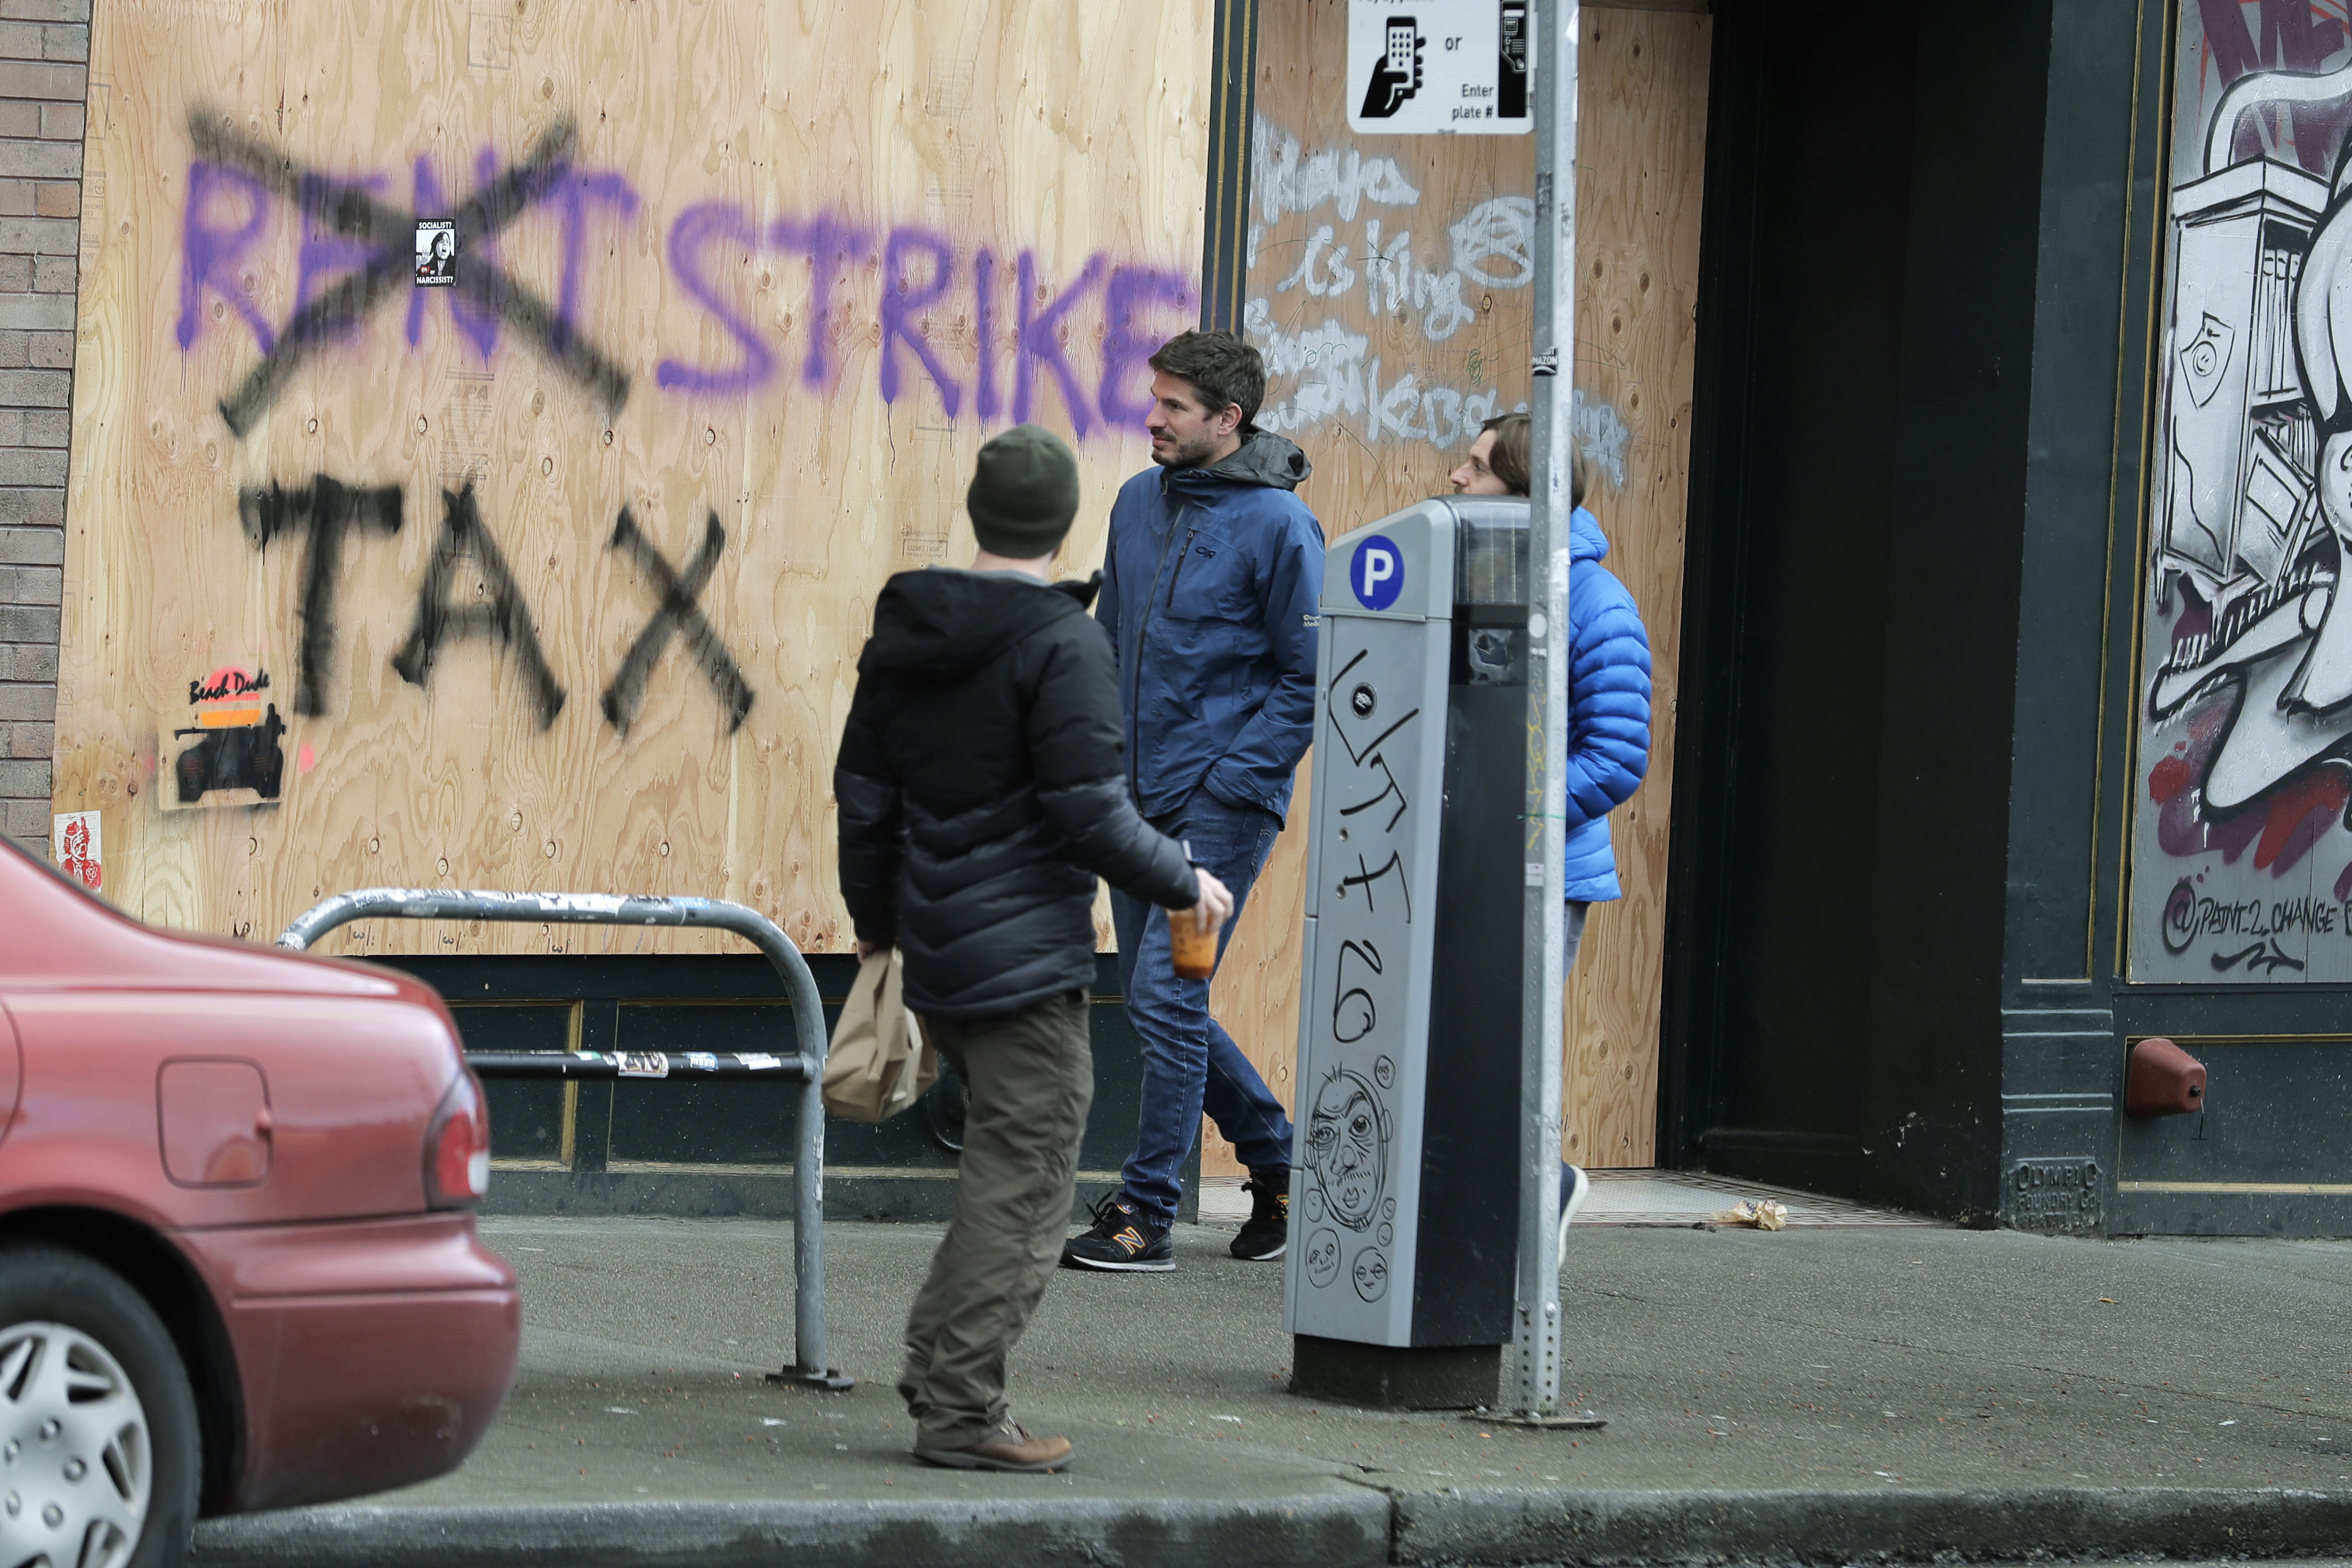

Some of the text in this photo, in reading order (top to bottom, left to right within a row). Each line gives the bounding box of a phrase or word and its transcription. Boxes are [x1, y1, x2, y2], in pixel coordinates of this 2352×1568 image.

[1445, 37, 1462, 50] or
[1462, 84, 1494, 97] Enter
[1452, 105, 1494, 121] plate #
[656, 201, 1199, 439] STRIKE
[1363, 549, 1394, 596] P
[239, 473, 755, 737] TAX
[189, 668, 270, 705] Beach Dude
[2016, 1161, 2098, 1191] OLYMPIC
